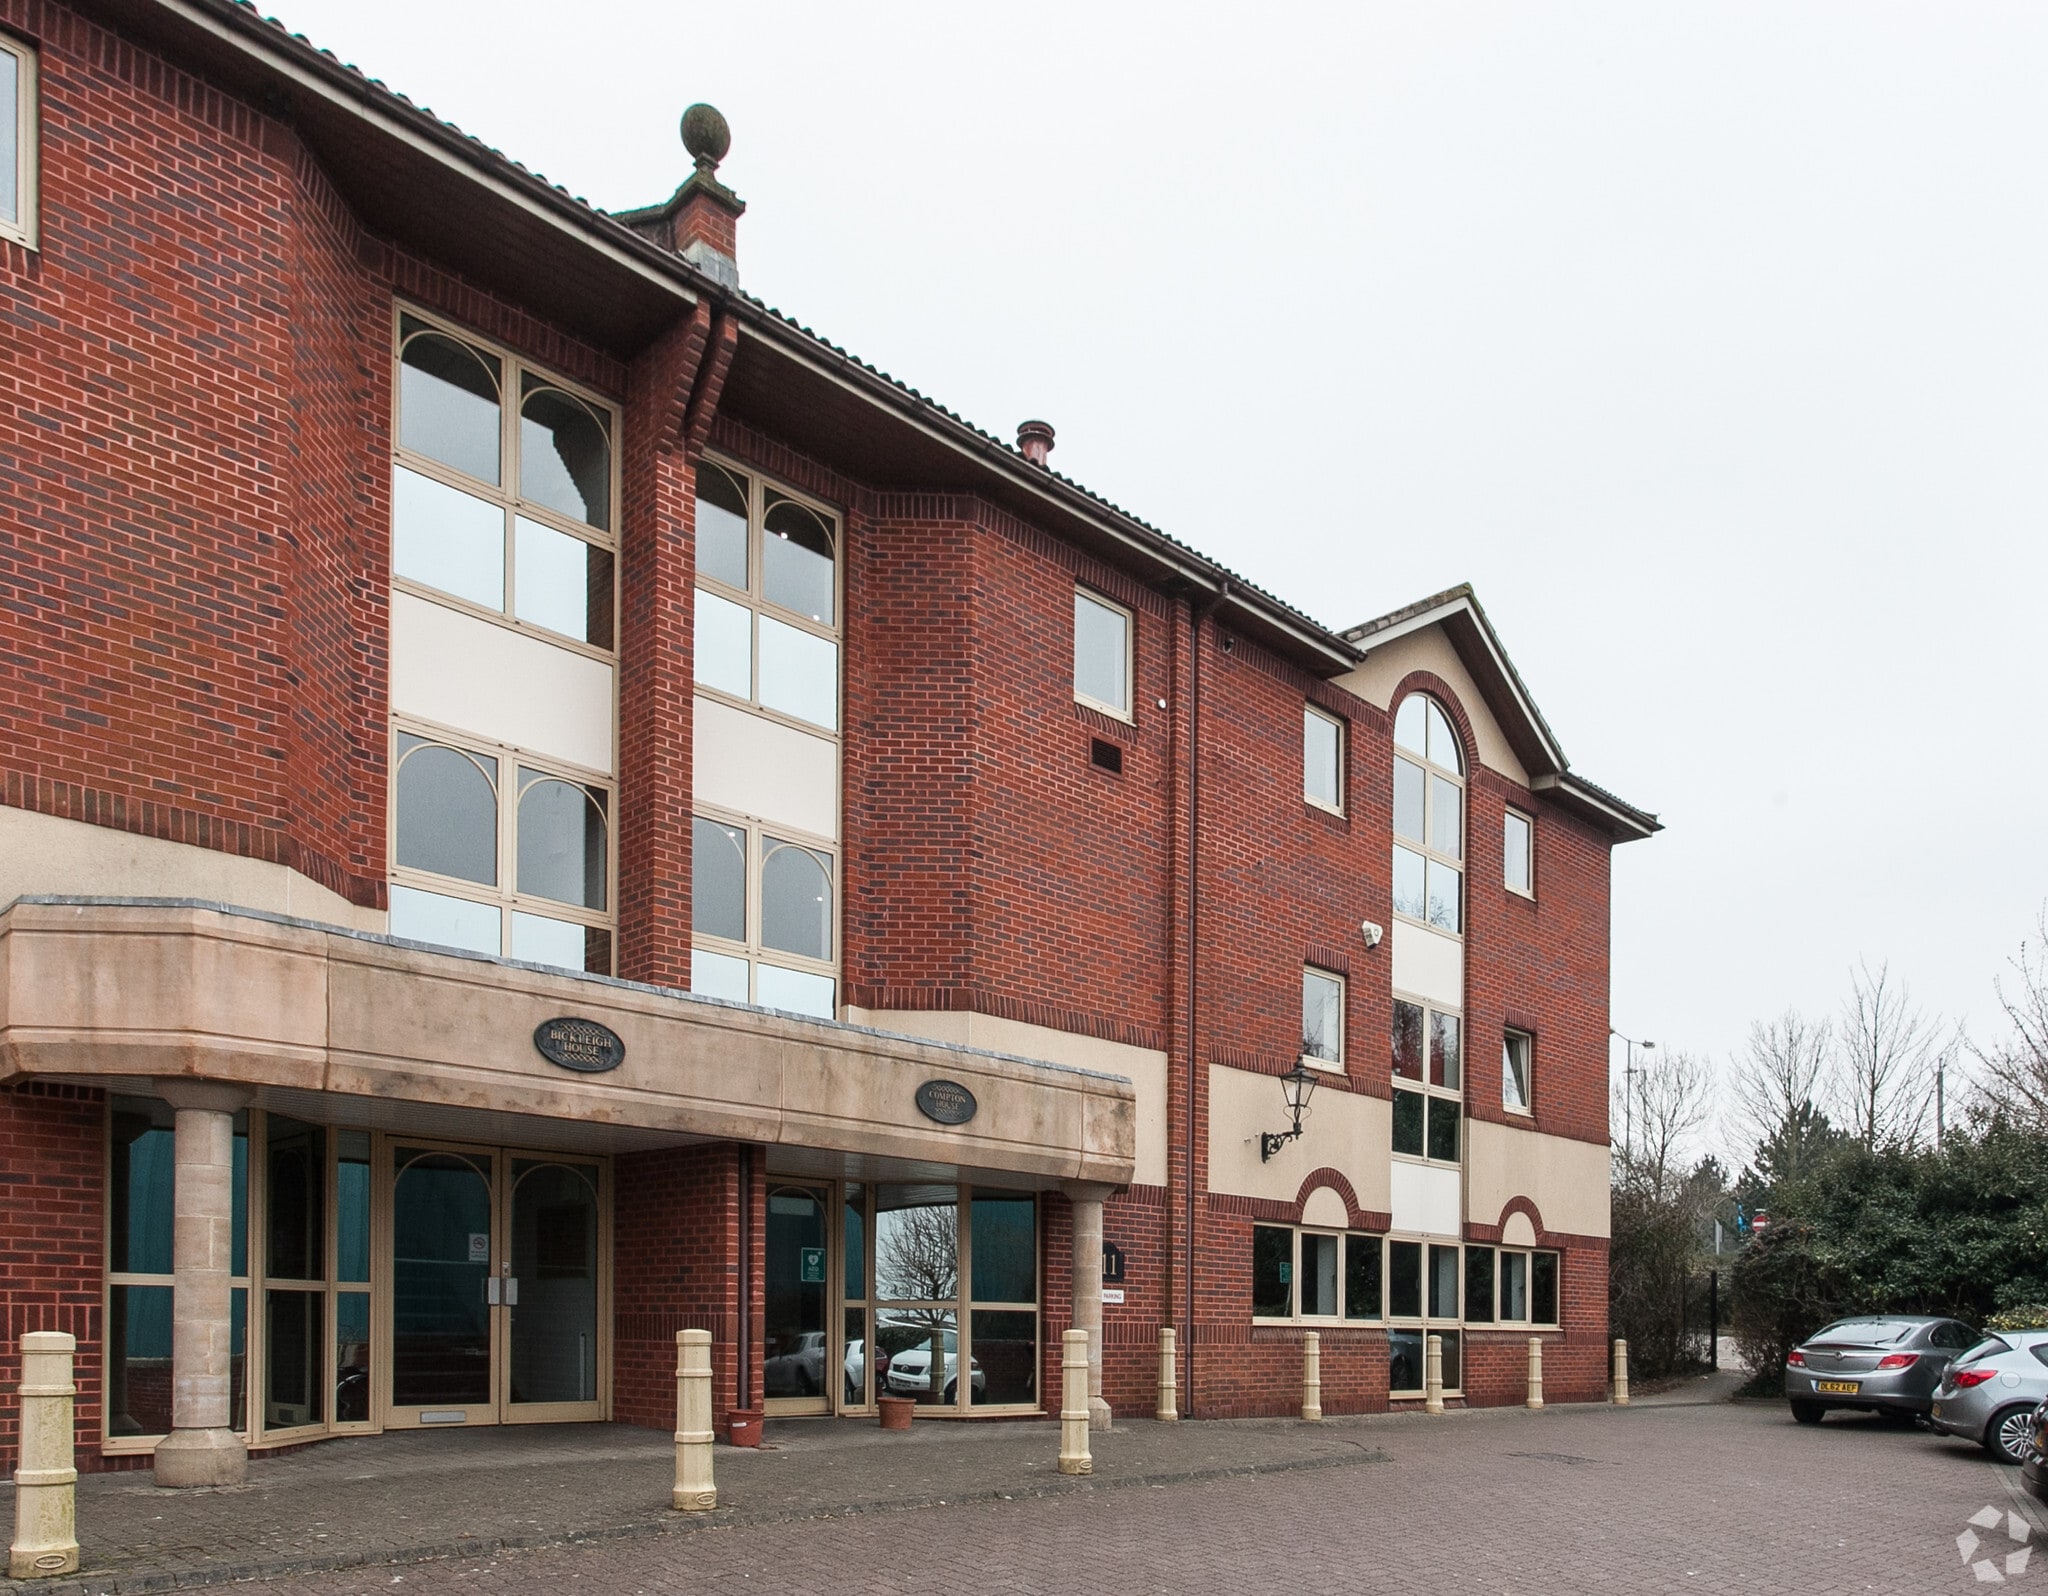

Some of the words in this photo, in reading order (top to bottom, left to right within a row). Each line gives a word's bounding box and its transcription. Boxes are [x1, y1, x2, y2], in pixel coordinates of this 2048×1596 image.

[550, 1029, 612, 1048] BICKLEIGH
[563, 1041, 600, 1055] HOUSE
[928, 1090, 966, 1103] COMPTON
